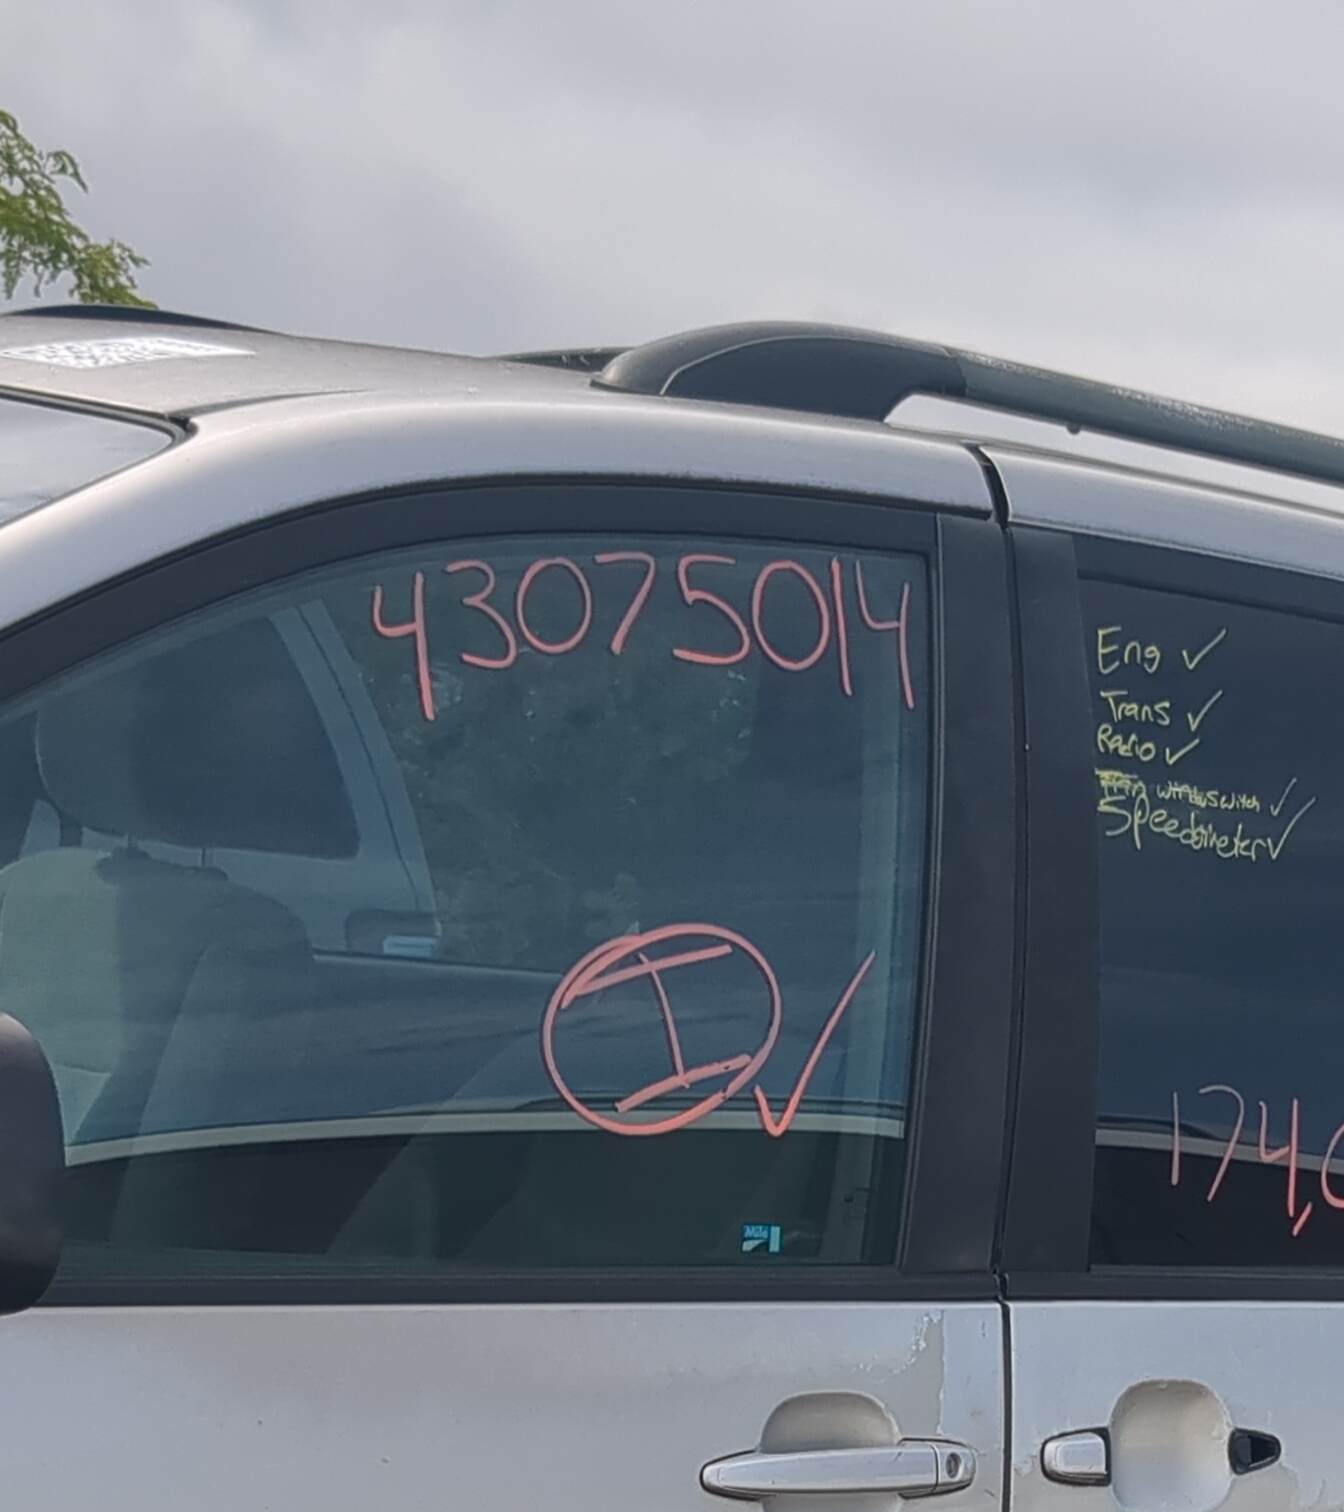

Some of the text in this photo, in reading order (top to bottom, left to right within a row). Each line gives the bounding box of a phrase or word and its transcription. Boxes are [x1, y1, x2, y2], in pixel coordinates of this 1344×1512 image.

[372, 551, 915, 721] 43075014
[1096, 626, 1161, 674] Eng
[1099, 690, 1171, 726] Trans
[1096, 724, 1156, 762] Radio
